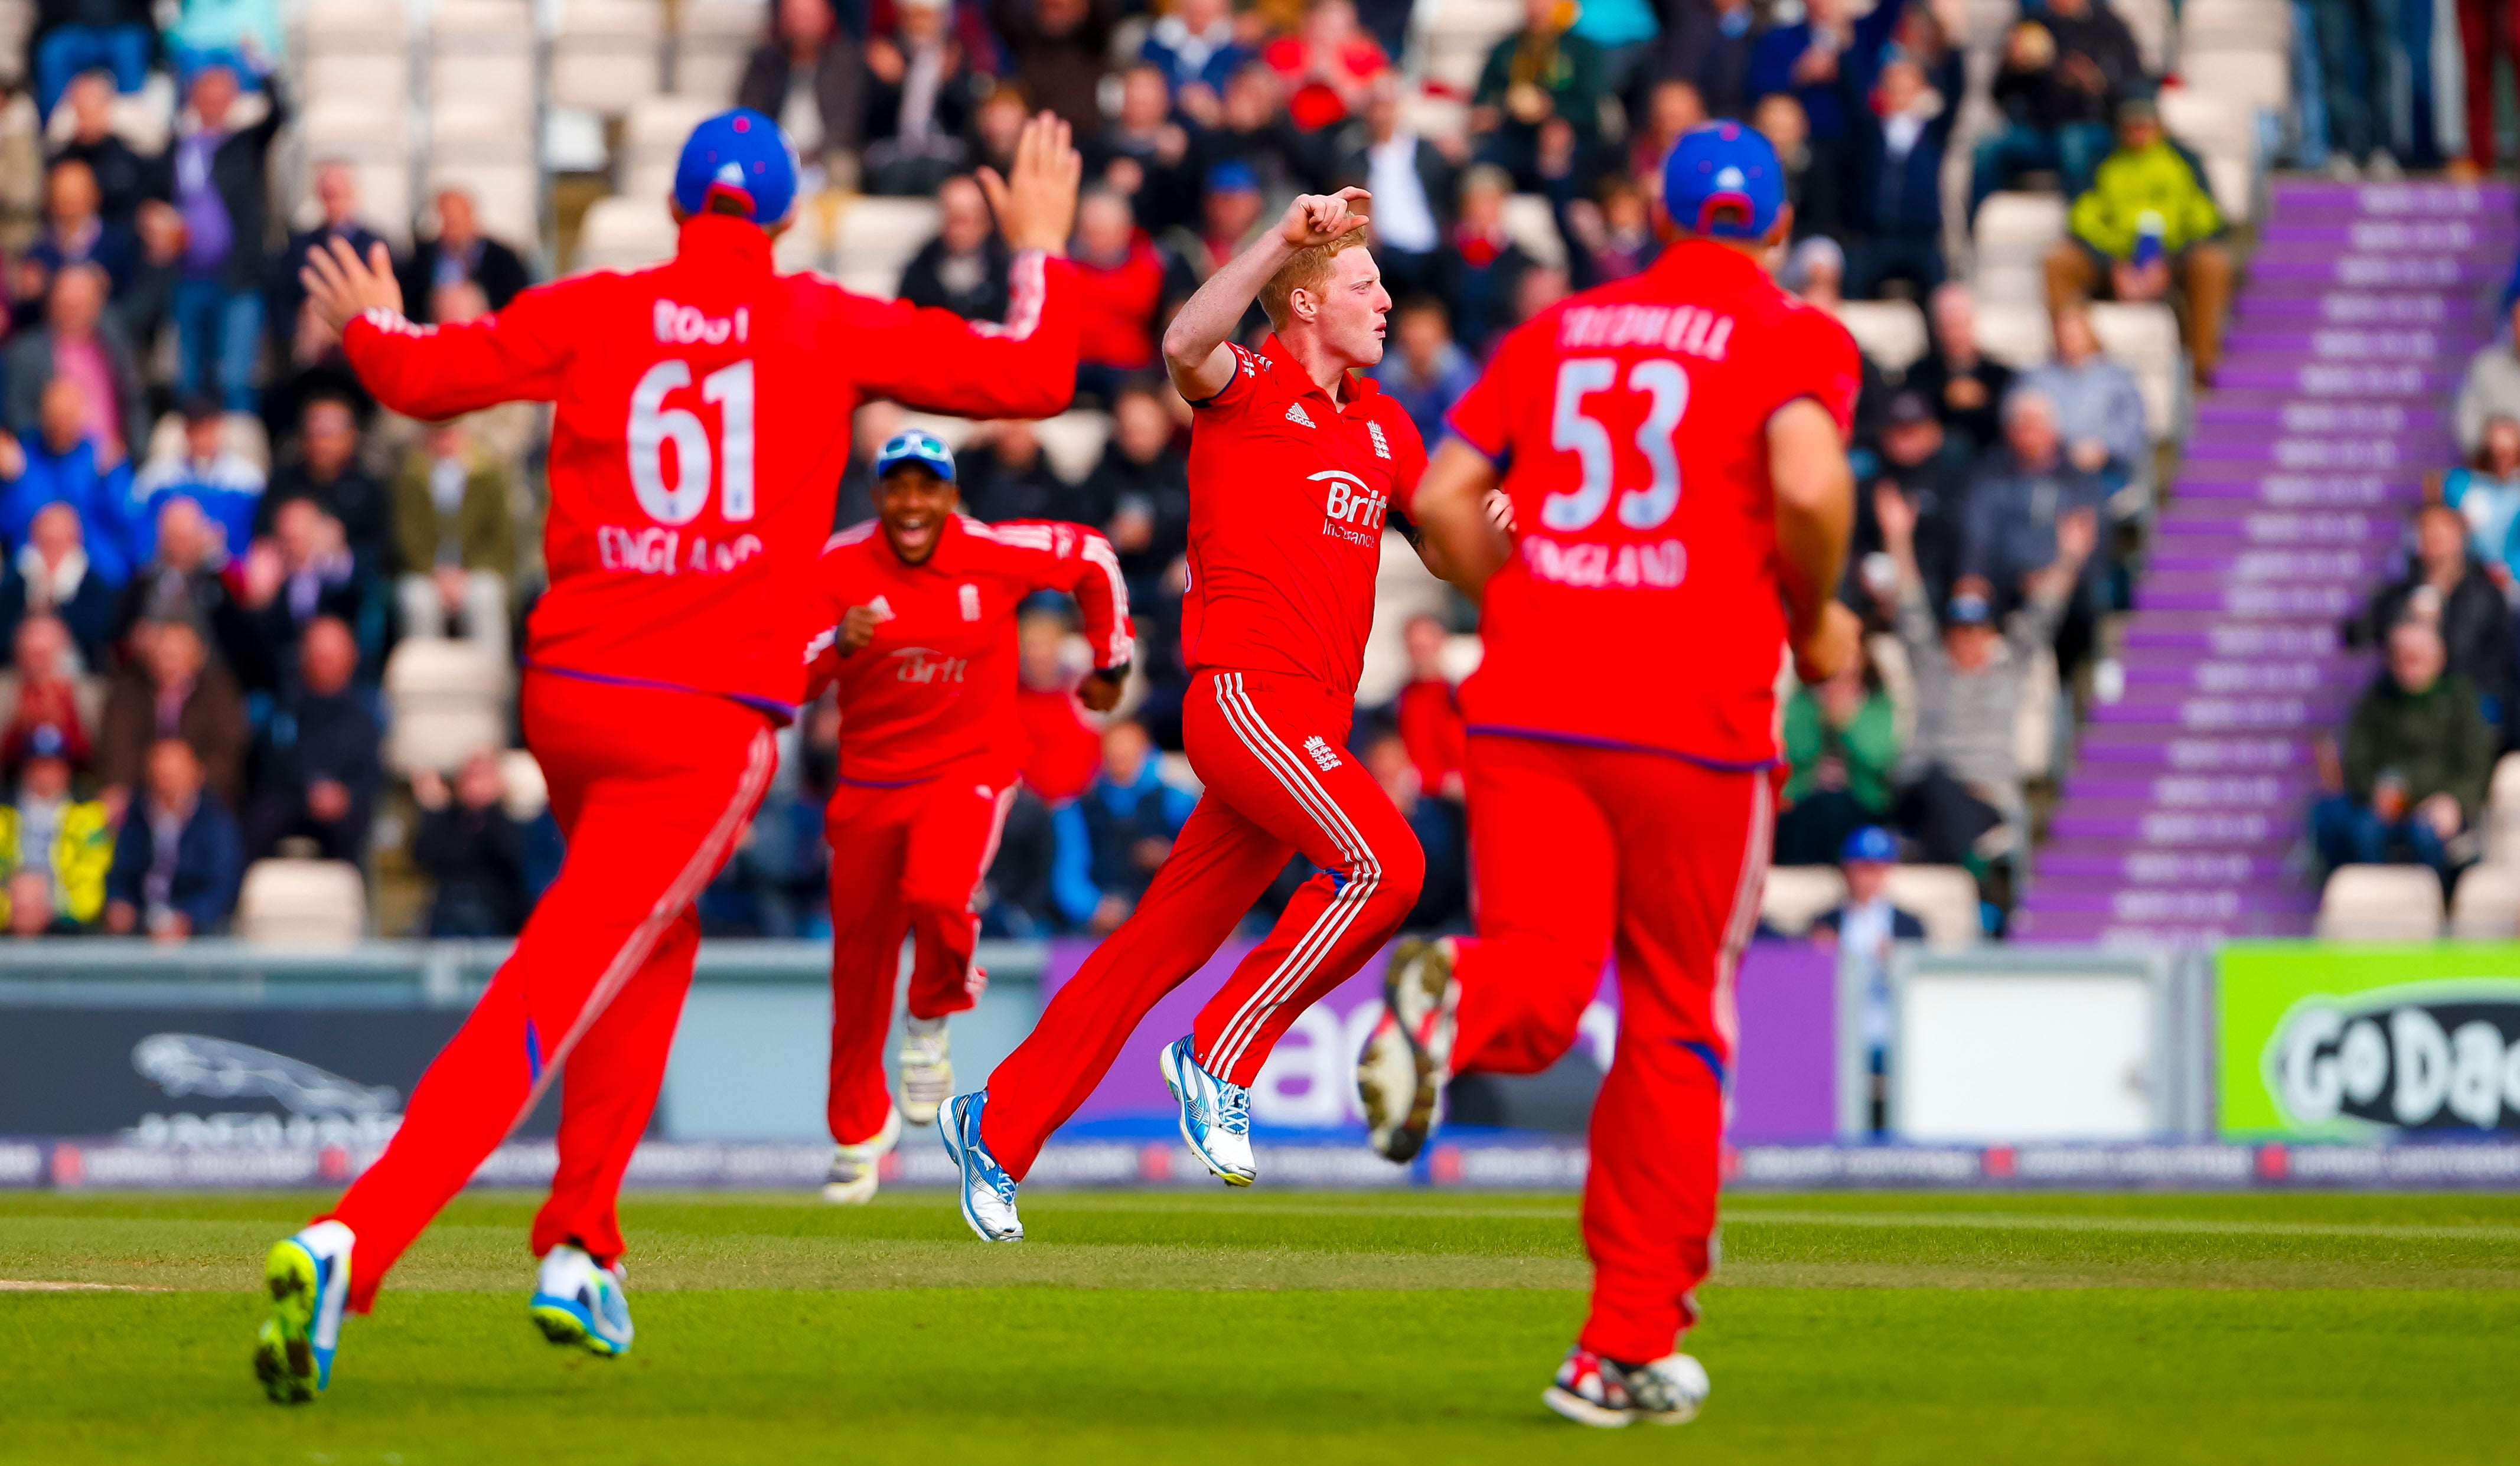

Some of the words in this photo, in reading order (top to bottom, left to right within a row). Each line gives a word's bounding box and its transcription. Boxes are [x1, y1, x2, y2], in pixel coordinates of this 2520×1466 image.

[627, 358, 755, 526] 61
[1285, 413, 1316, 429] adidas
[1541, 357, 1690, 531] 53
[1326, 481, 1387, 529] Brit
